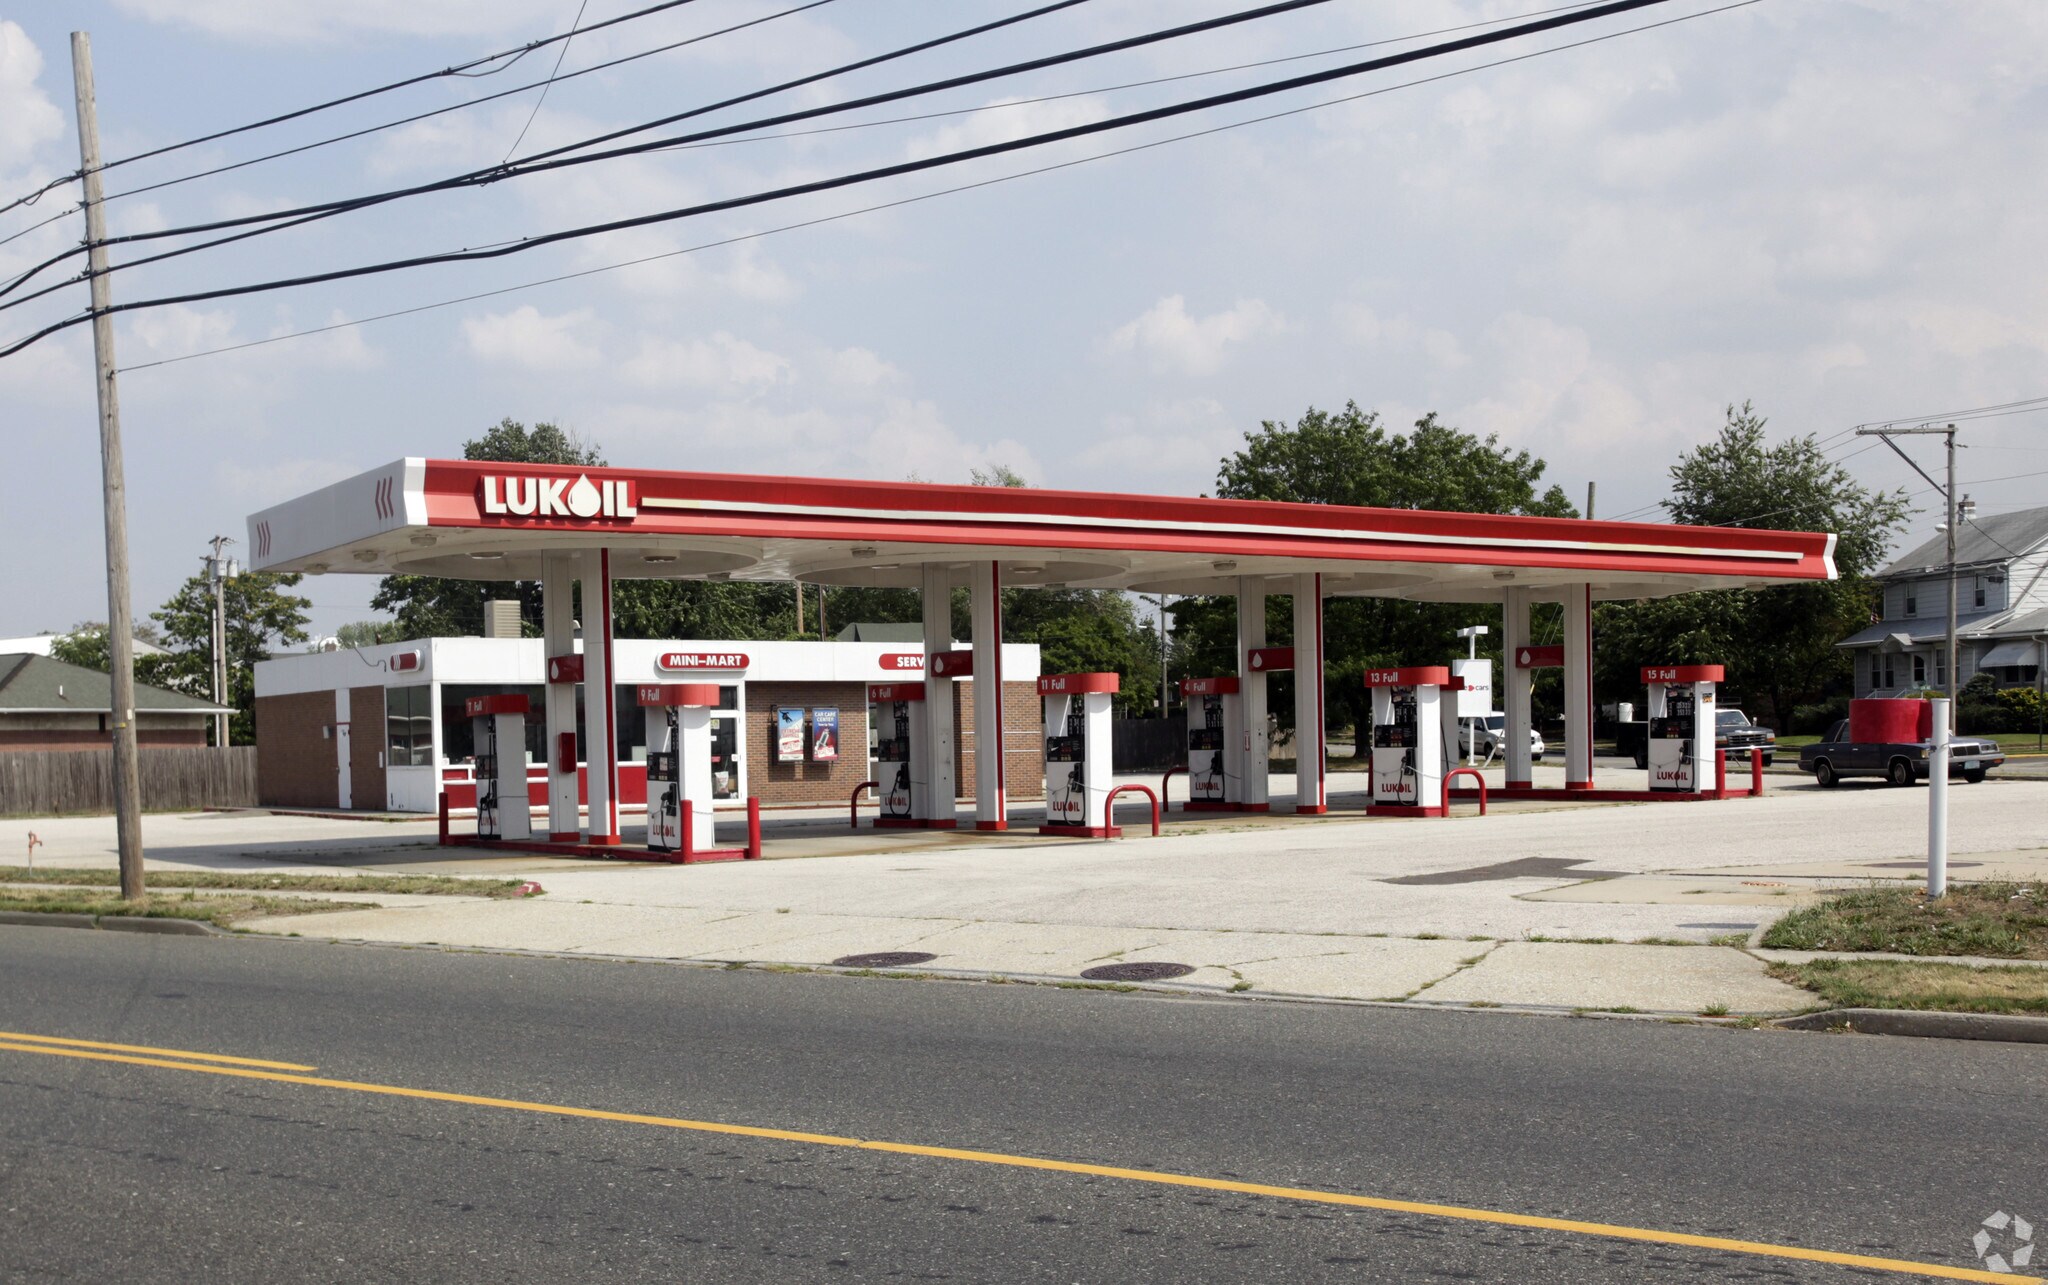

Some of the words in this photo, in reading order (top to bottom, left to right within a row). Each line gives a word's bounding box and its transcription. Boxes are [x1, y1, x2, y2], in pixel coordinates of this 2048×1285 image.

[483, 473, 637, 517] LUKOIL
[1371, 673, 1380, 682] 13
[1383, 672, 1398, 683] Full
[1648, 670, 1657, 679] 15
[1660, 669, 1676, 679] Full
[1041, 679, 1049, 690] 11
[1051, 678, 1066, 690] Full
[1193, 682, 1206, 692] Full
[641, 689, 646, 701] 9
[648, 689, 660, 701] Full
[872, 688, 877, 698] 6
[879, 687, 892, 698] Full
[1657, 772, 1688, 781] LUKOIL
[1196, 782, 1220, 791] LUKOIL
[1382, 783, 1412, 793] LUKOIL
[1053, 801, 1080, 812] LUKOIL
